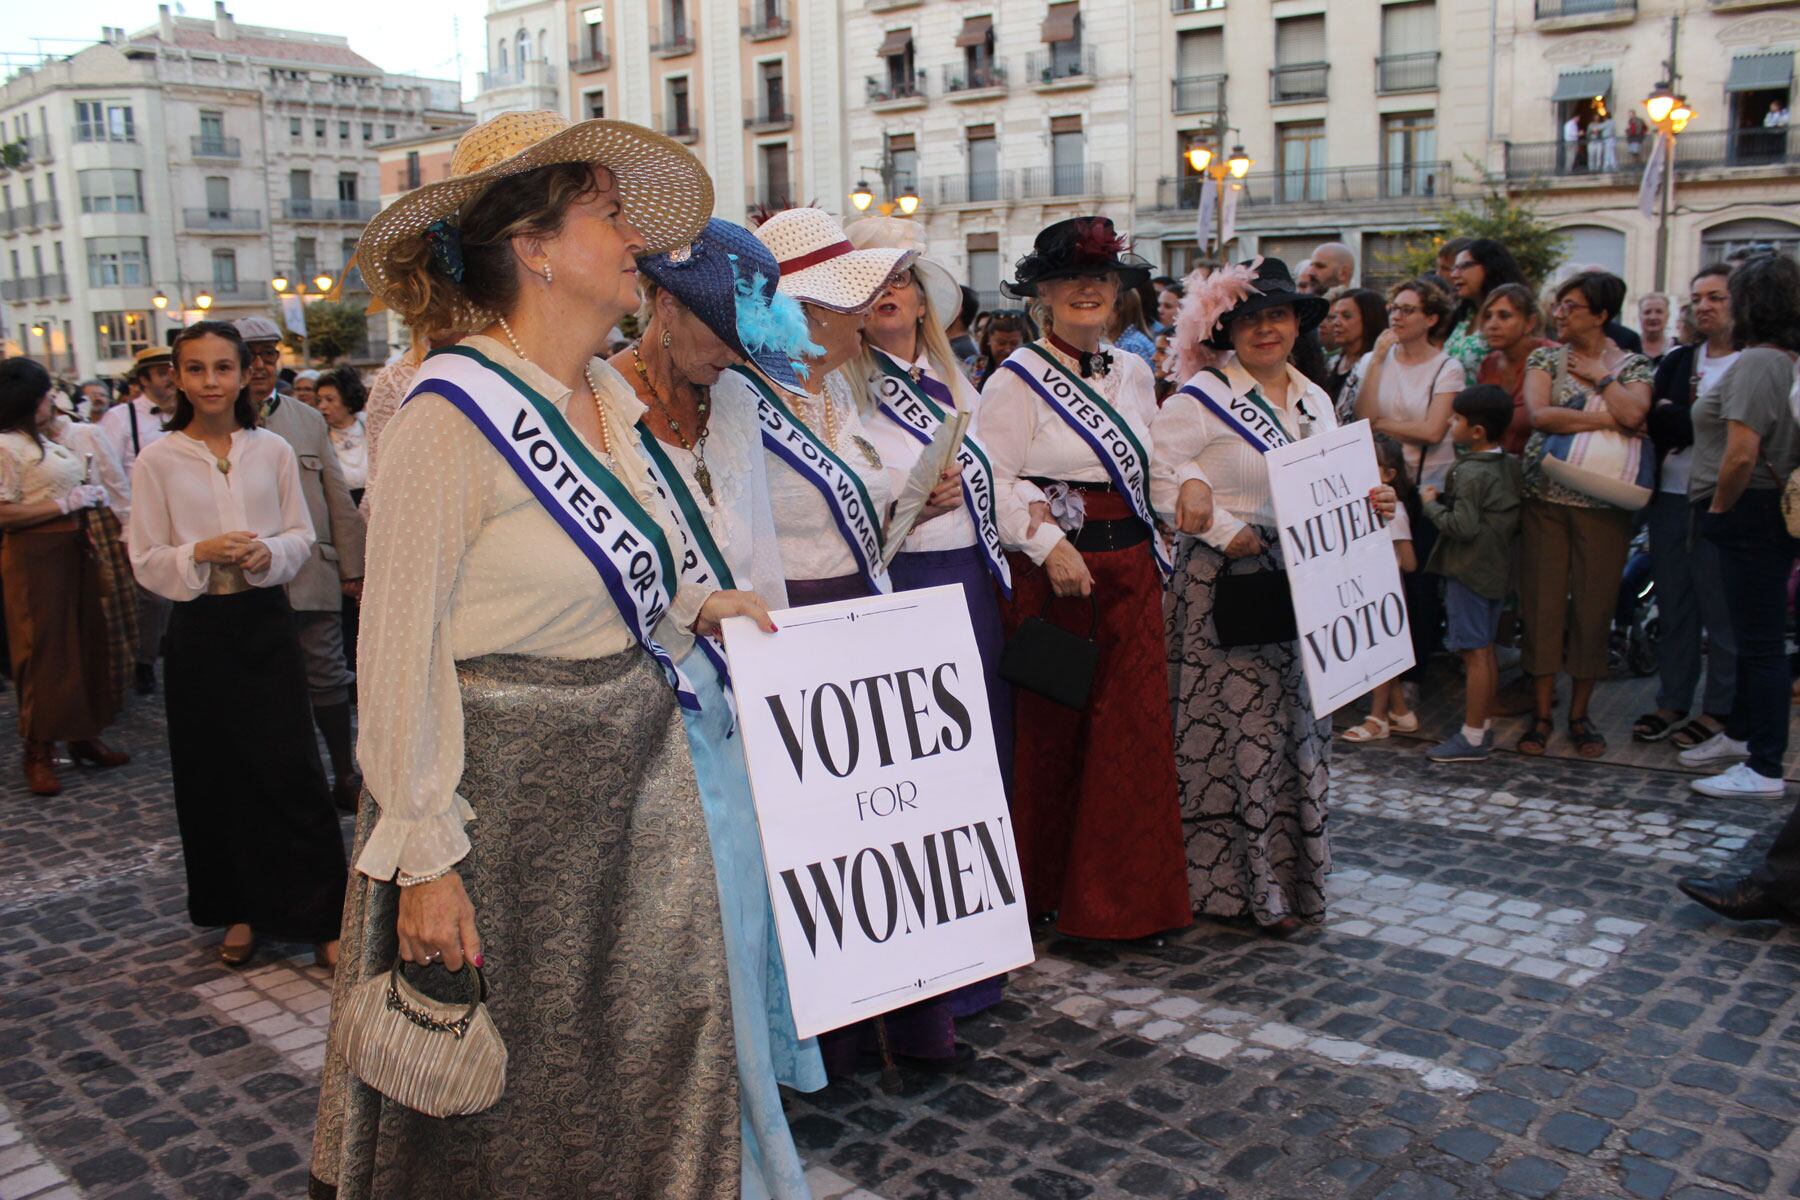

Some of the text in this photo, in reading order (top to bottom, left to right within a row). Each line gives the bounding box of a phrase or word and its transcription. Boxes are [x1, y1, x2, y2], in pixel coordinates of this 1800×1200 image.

[787, 429, 833, 476] FOR
[1043, 368, 1104, 429] VOTES
[1101, 428, 1135, 473] FOR
[511, 408, 656, 602] VOTES FOR
[1310, 473, 1351, 507] UNA
[1336, 575, 1364, 608] UN
[1304, 592, 1404, 674] VOTO
[765, 662, 972, 784] VOTES
[856, 780, 918, 821] FOR
[779, 817, 1016, 960] WOMEN
